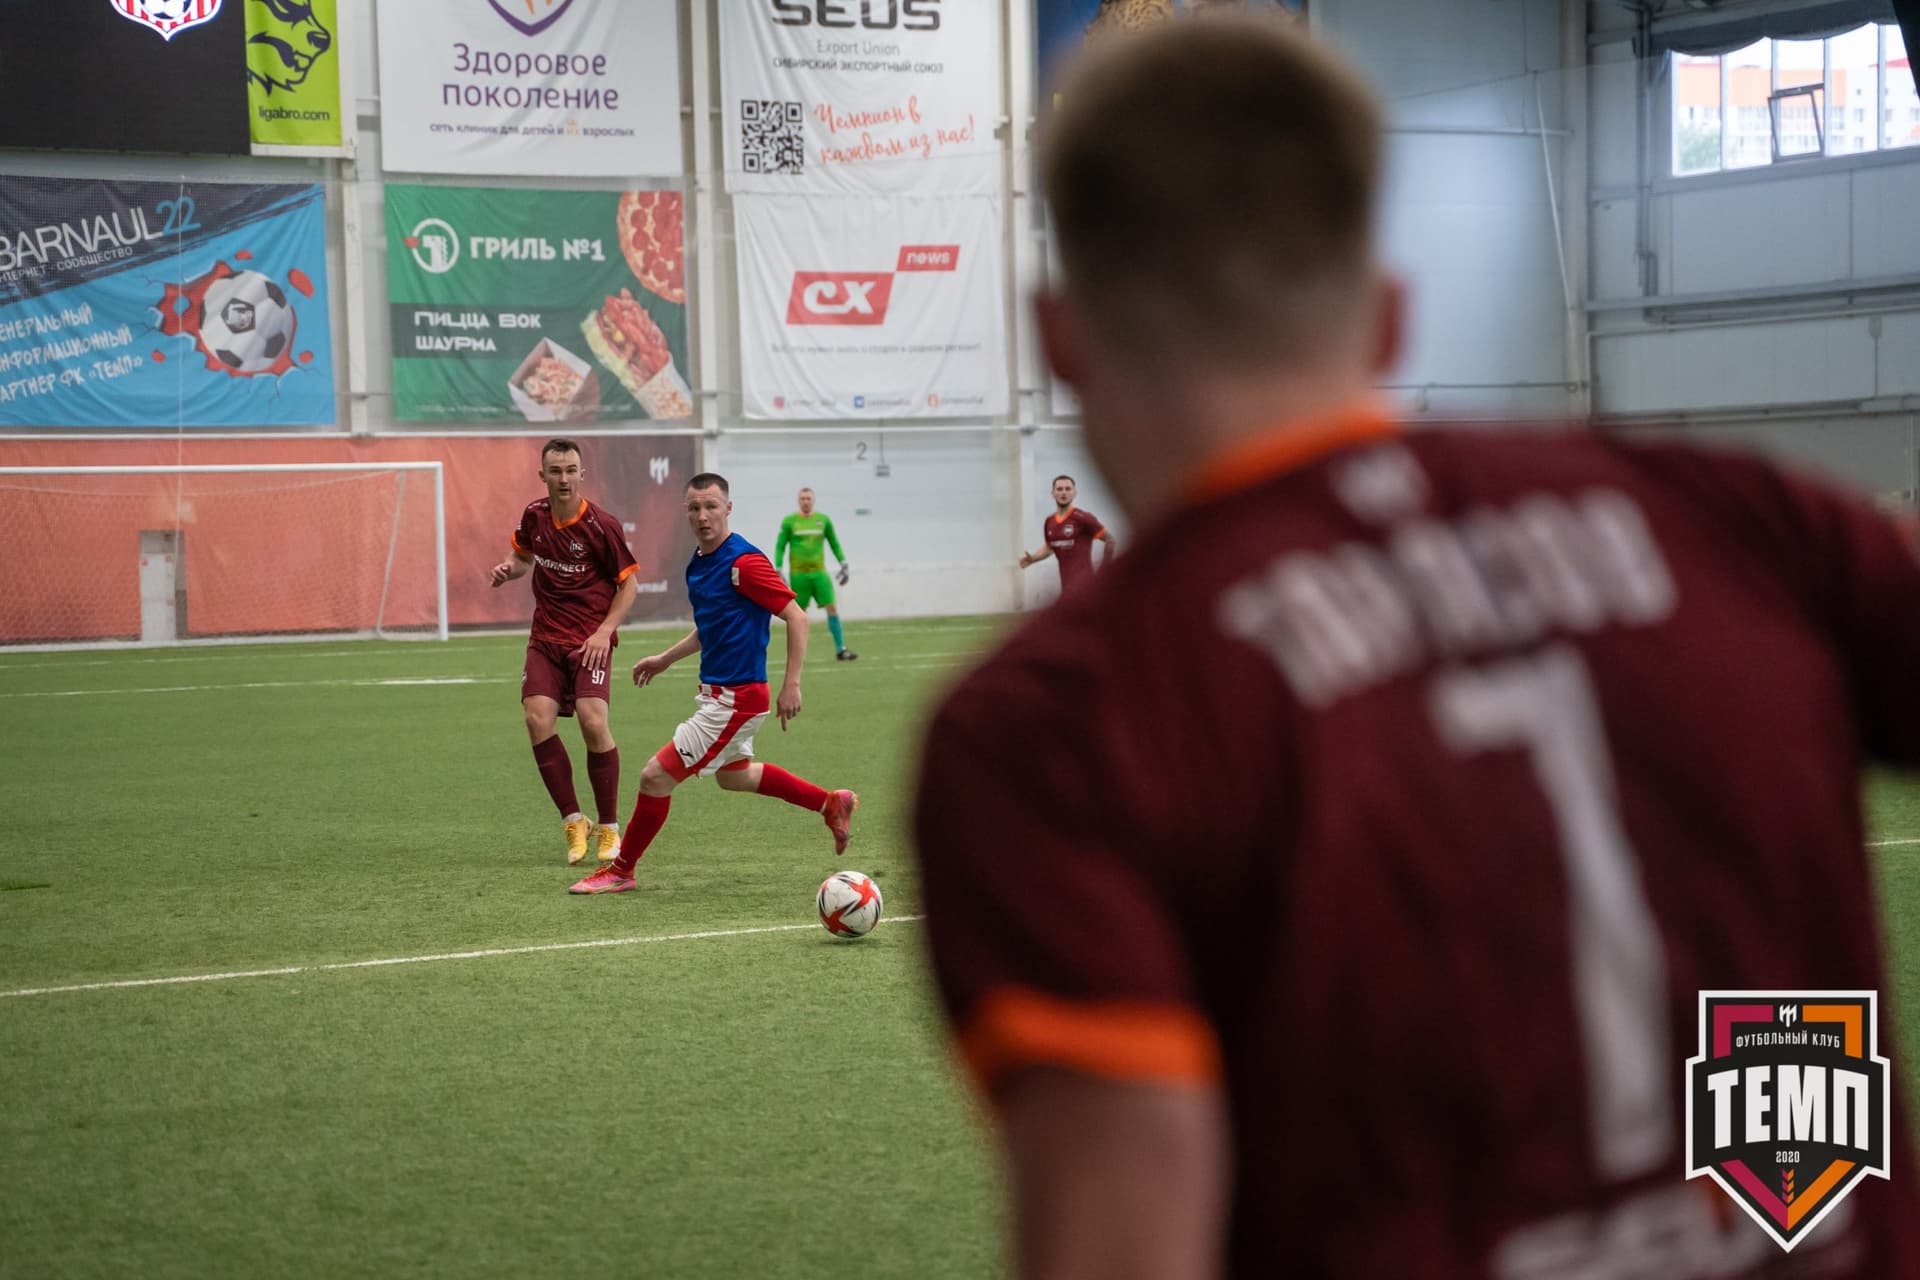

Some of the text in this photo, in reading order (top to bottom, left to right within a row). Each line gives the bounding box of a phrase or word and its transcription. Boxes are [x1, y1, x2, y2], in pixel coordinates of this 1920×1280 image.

[772, 0, 940, 31] SEUS
[817, 40, 900, 56] Export Union
[453, 43, 607, 77] Здоровое
[773, 56, 944, 74] СИБИРСКИЙ ЭКСПОРТНЫЙ СОЮЗ
[443, 83, 619, 110] поколение
[258, 105, 330, 121] ligabro.com
[813, 95, 922, 134] Чемпион в
[430, 123, 454, 134] сеть
[500, 125, 520, 137] для
[522, 124, 555, 137] детей
[583, 126, 636, 139] взрослых
[821, 113, 975, 164] каждом из нас!
[57, 246, 133, 271] СООБЩЕСТВО
[470, 236, 607, 261] ГРИЛЬ №1
[907, 251, 951, 265] news
[414, 312, 541, 329] ПИЦЦА ВОК
[415, 336, 496, 351] ШАУРМА
[60, 367, 85, 387] ФК
[855, 440, 868, 461] 2
[591, 669, 605, 685] 97
